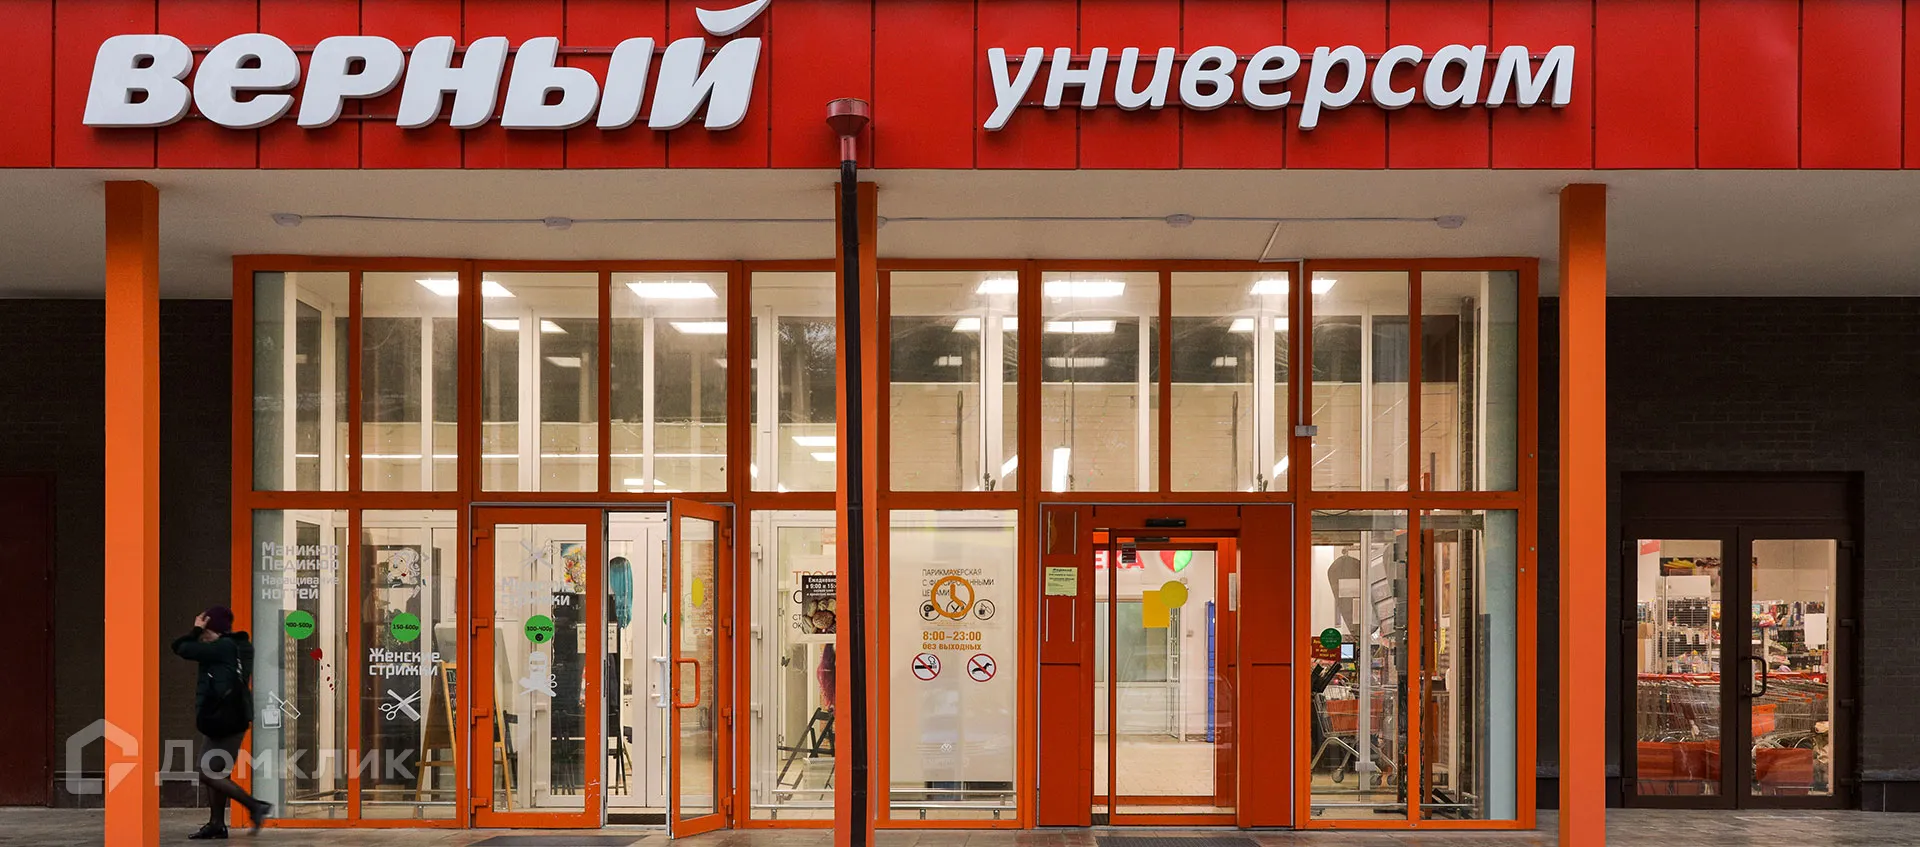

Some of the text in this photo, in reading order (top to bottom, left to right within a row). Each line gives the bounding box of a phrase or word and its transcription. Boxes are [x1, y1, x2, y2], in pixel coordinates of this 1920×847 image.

[984, 44, 1575, 131] универсам
[262, 541, 339, 559] Маникюр
[262, 555, 339, 573] Педикюр
[262, 575, 339, 587] Наращивание
[502, 577, 572, 592] Мсие
[262, 584, 319, 600] ногтей
[922, 589, 950, 597] ЦЕАМИ
[369, 647, 441, 662] Женские
[369, 663, 438, 679] стрижки
